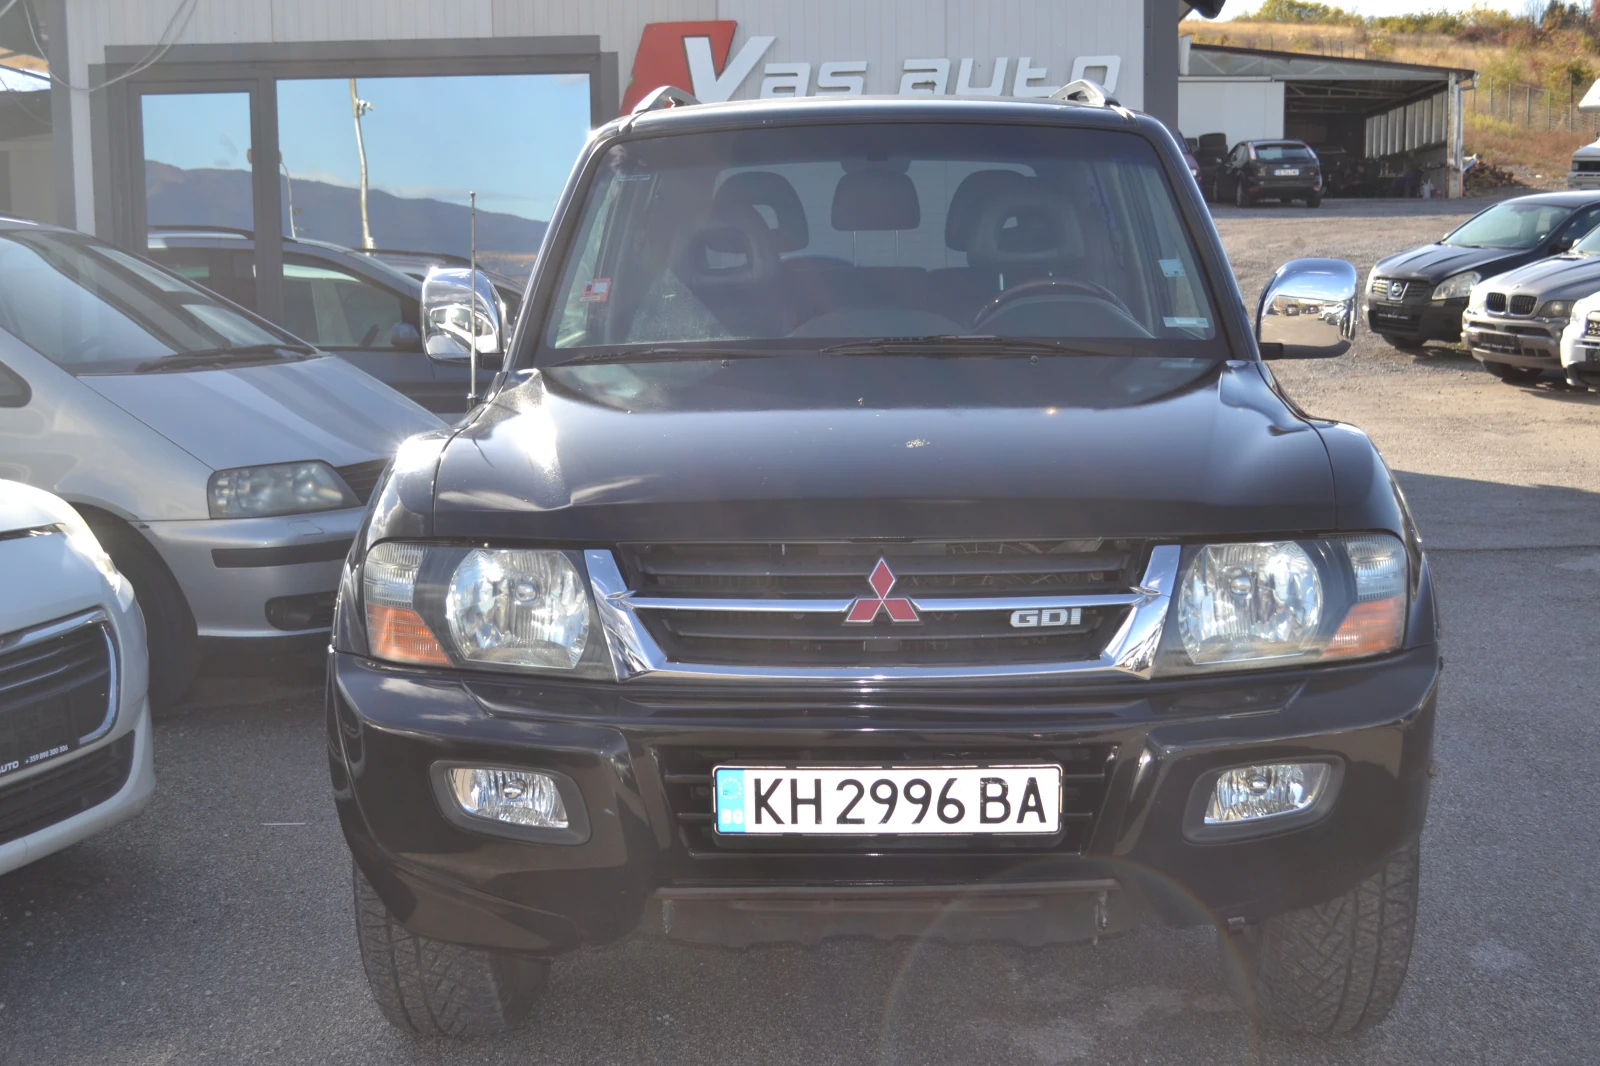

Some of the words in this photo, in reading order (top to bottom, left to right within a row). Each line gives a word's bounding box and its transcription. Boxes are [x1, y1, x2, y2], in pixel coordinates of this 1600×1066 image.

[683, 36, 867, 102] Vas
[899, 55, 1121, 98] auto
[1010, 608, 1081, 628] GDI
[0, 760, 19, 773] UTO
